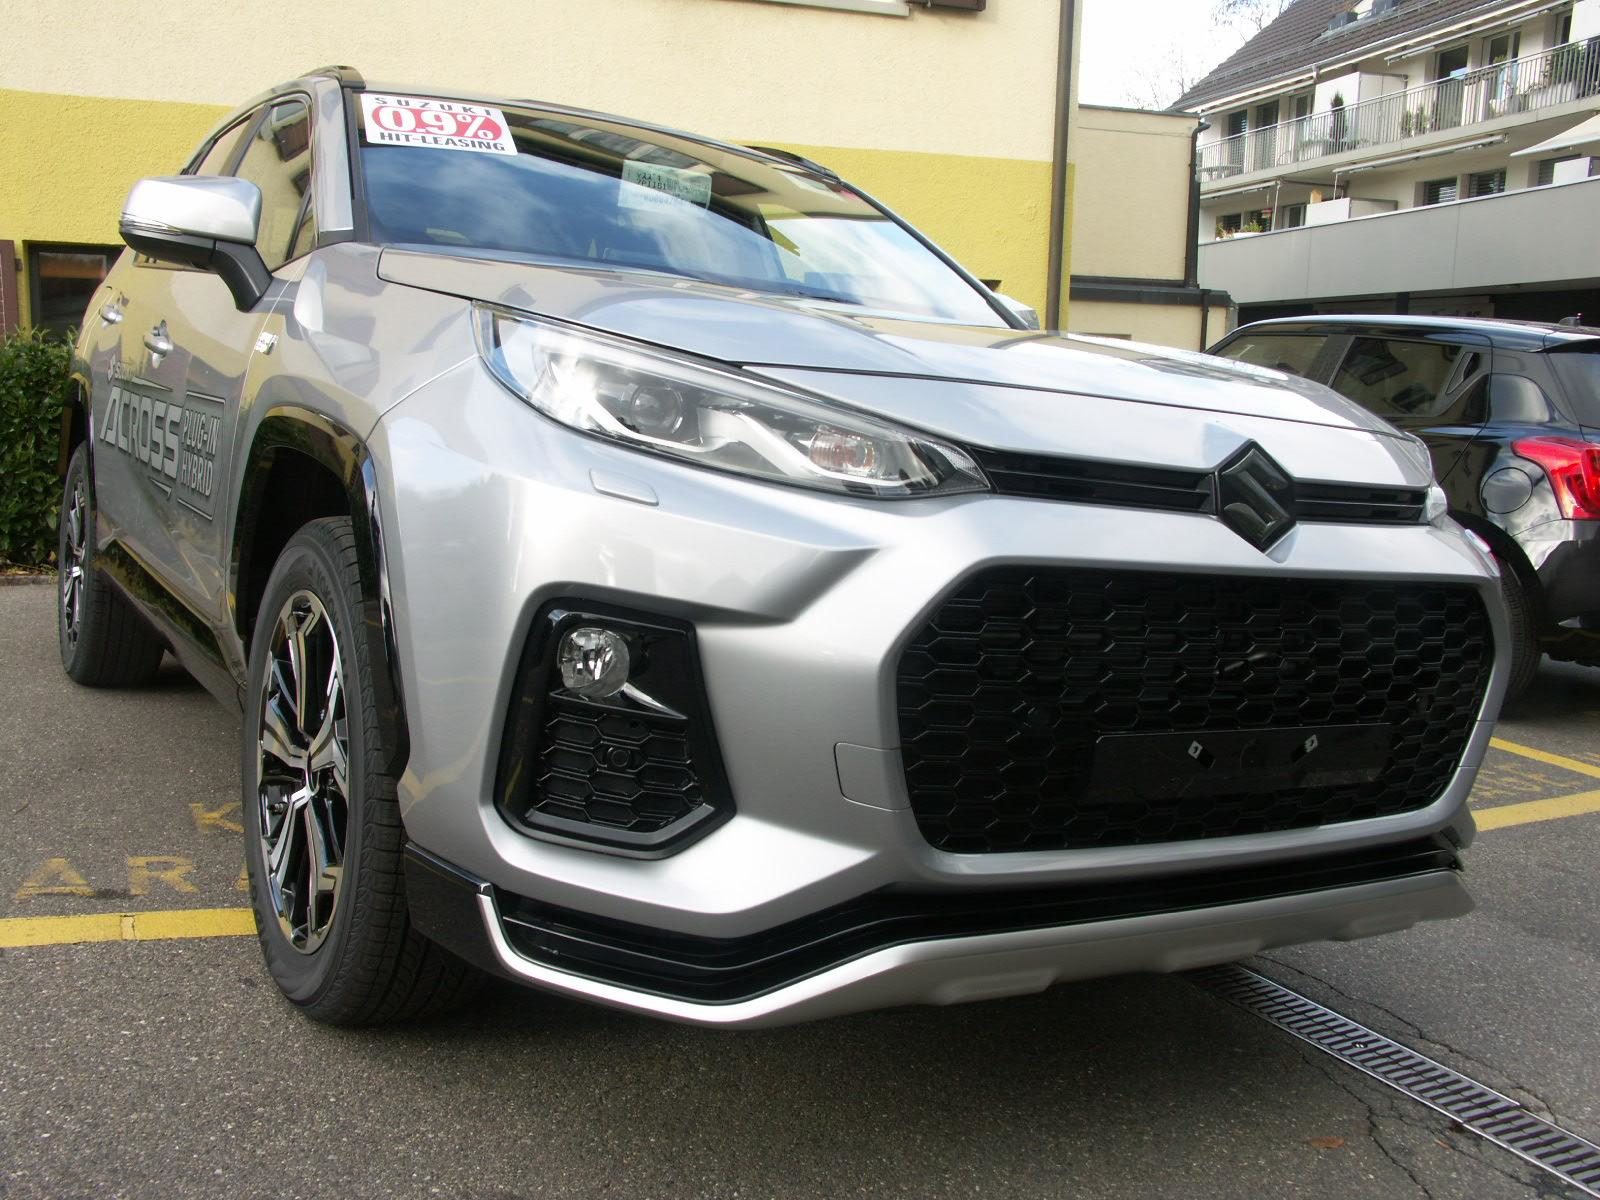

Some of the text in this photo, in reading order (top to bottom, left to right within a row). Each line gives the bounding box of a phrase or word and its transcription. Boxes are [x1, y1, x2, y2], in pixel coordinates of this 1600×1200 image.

[374, 96, 492, 117] SUZUKI
[378, 106, 495, 141] 0.9%
[379, 131, 506, 152] HIT-LEASING
[100, 386, 183, 479] ACROSS
[182, 409, 221, 456] PLUG-IN
[181, 450, 214, 497] HYBRID
